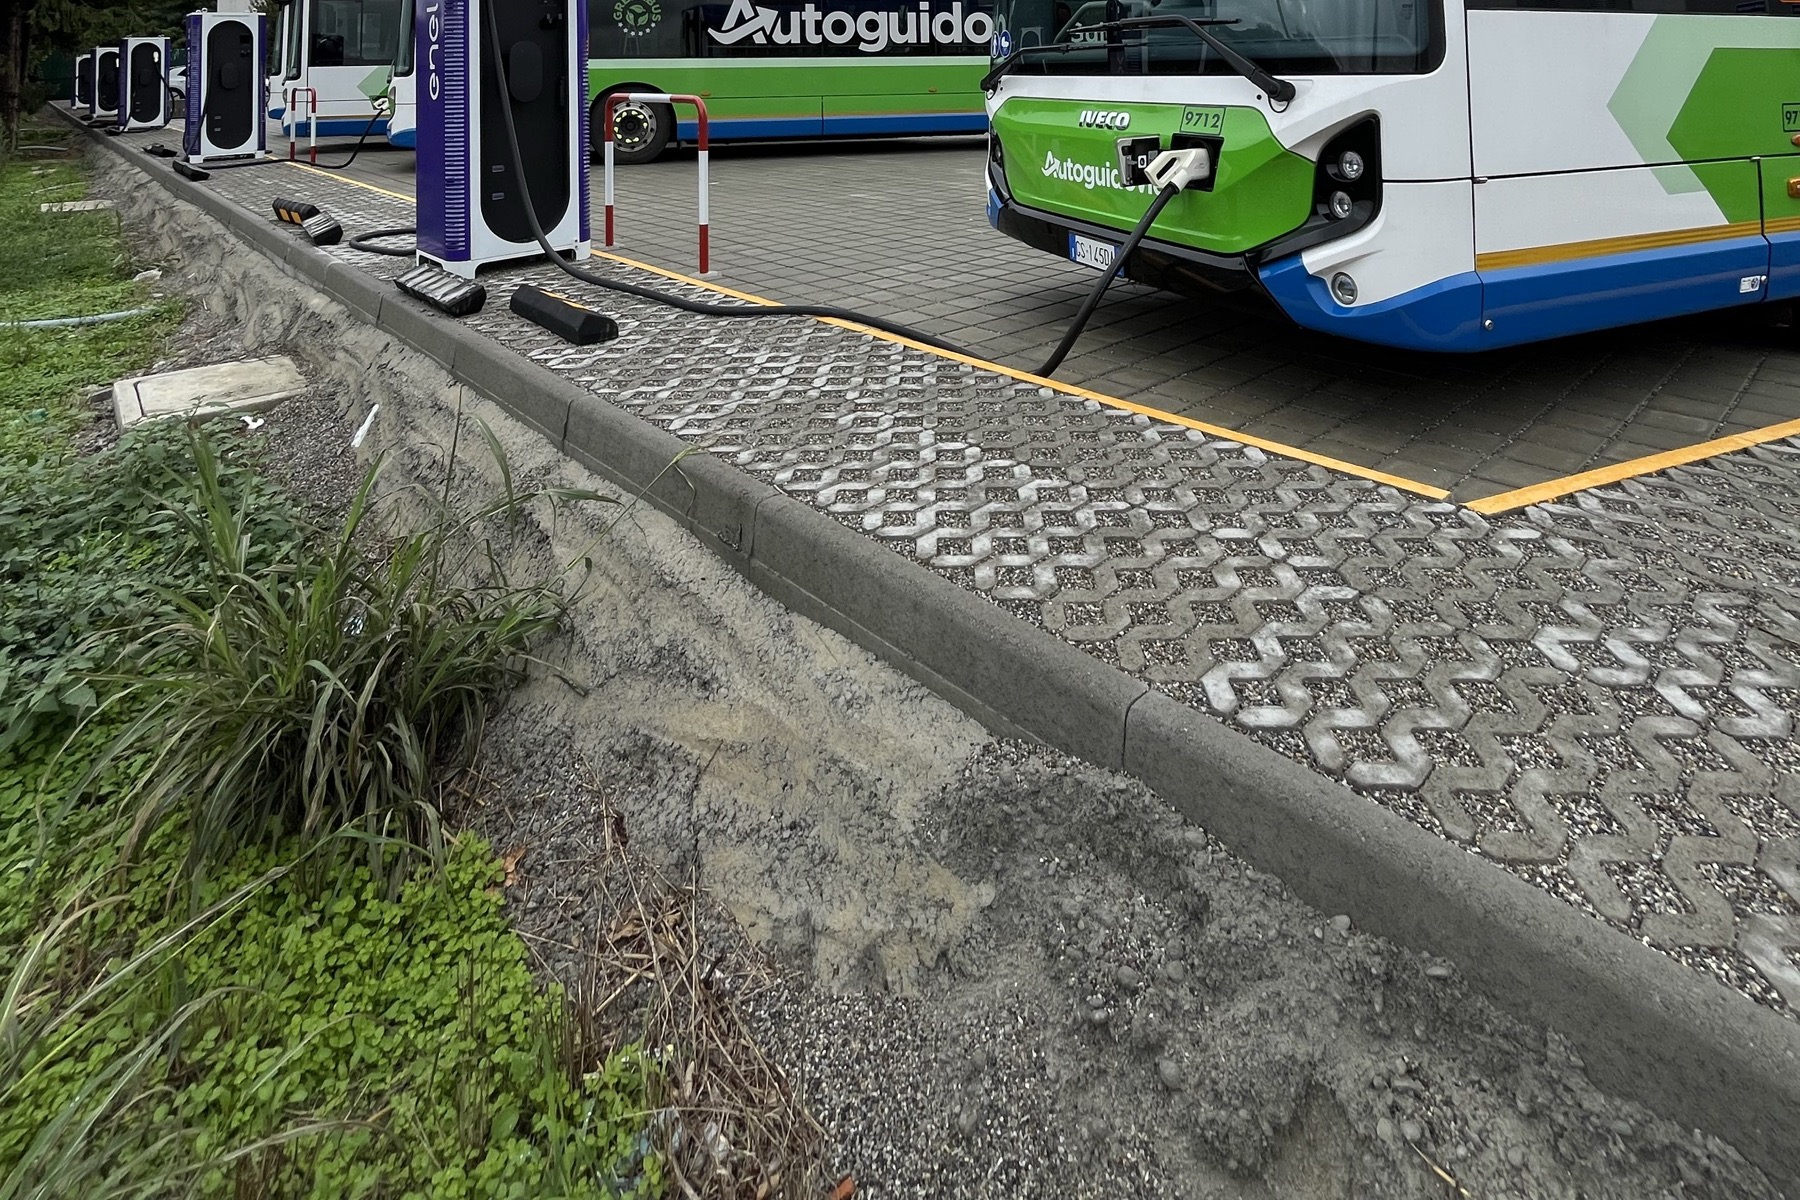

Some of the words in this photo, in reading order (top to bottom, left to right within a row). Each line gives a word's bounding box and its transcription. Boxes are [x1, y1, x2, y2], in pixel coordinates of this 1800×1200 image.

[426, 3, 439, 100] enel
[1079, 111, 1130, 130] IVECO
[1185, 111, 1221, 129] 9712
[1785, 110, 1800, 125] 97
